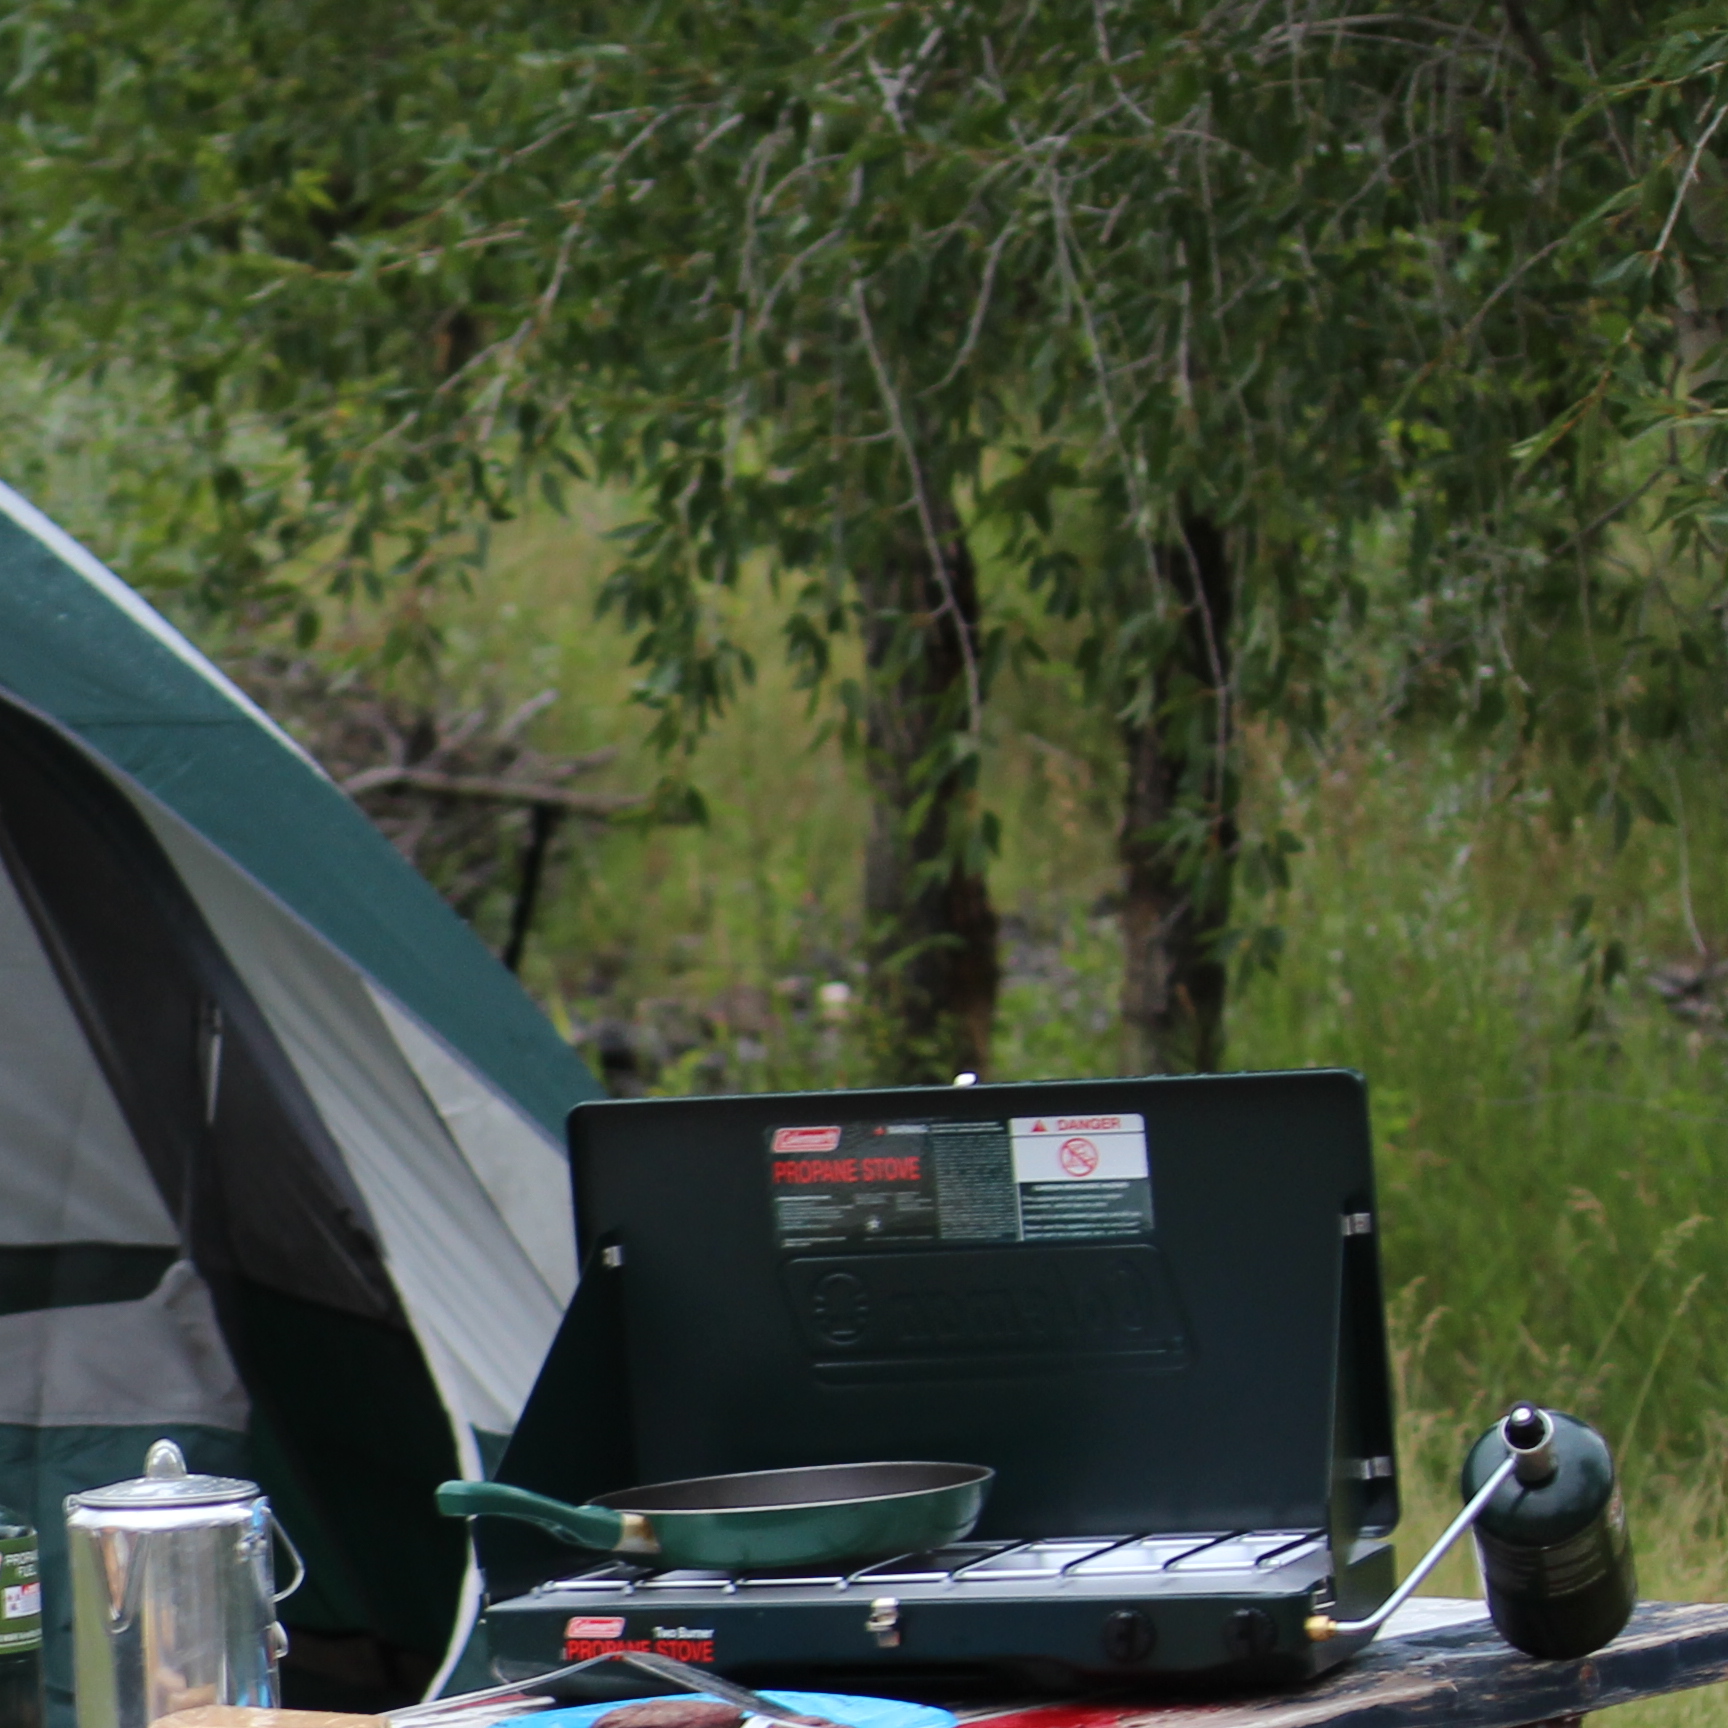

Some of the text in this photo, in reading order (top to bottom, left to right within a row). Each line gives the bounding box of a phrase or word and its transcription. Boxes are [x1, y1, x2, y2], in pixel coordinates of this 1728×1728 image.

[1057, 1117, 1121, 1131] DANGER
[773, 1156, 922, 1184] PROPANE STOVE
